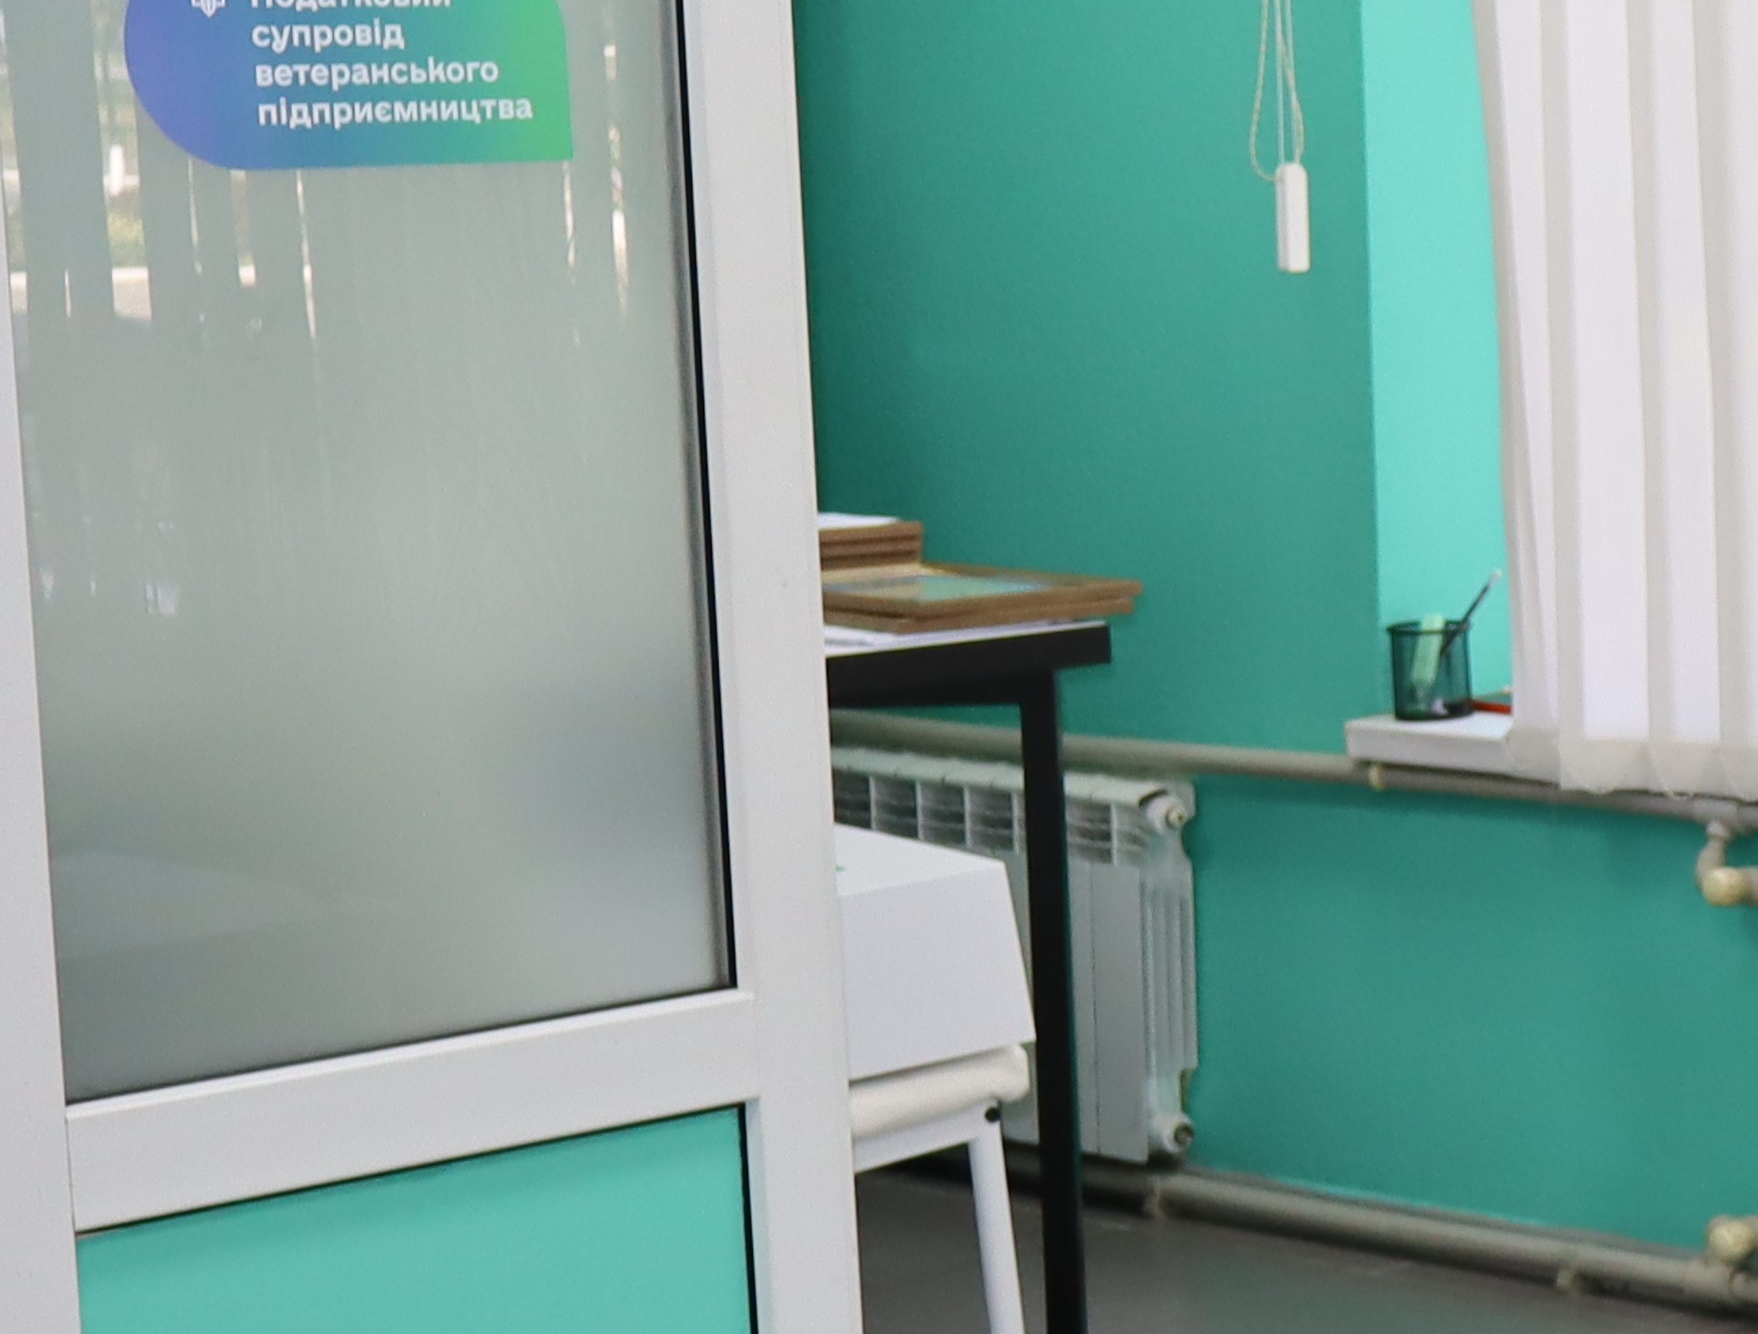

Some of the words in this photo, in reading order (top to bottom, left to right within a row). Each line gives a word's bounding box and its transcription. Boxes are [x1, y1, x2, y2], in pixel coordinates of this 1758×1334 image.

[251, 17, 406, 53] супровід
[255, 56, 501, 91] ветеранського
[257, 96, 534, 130] підприємництва
